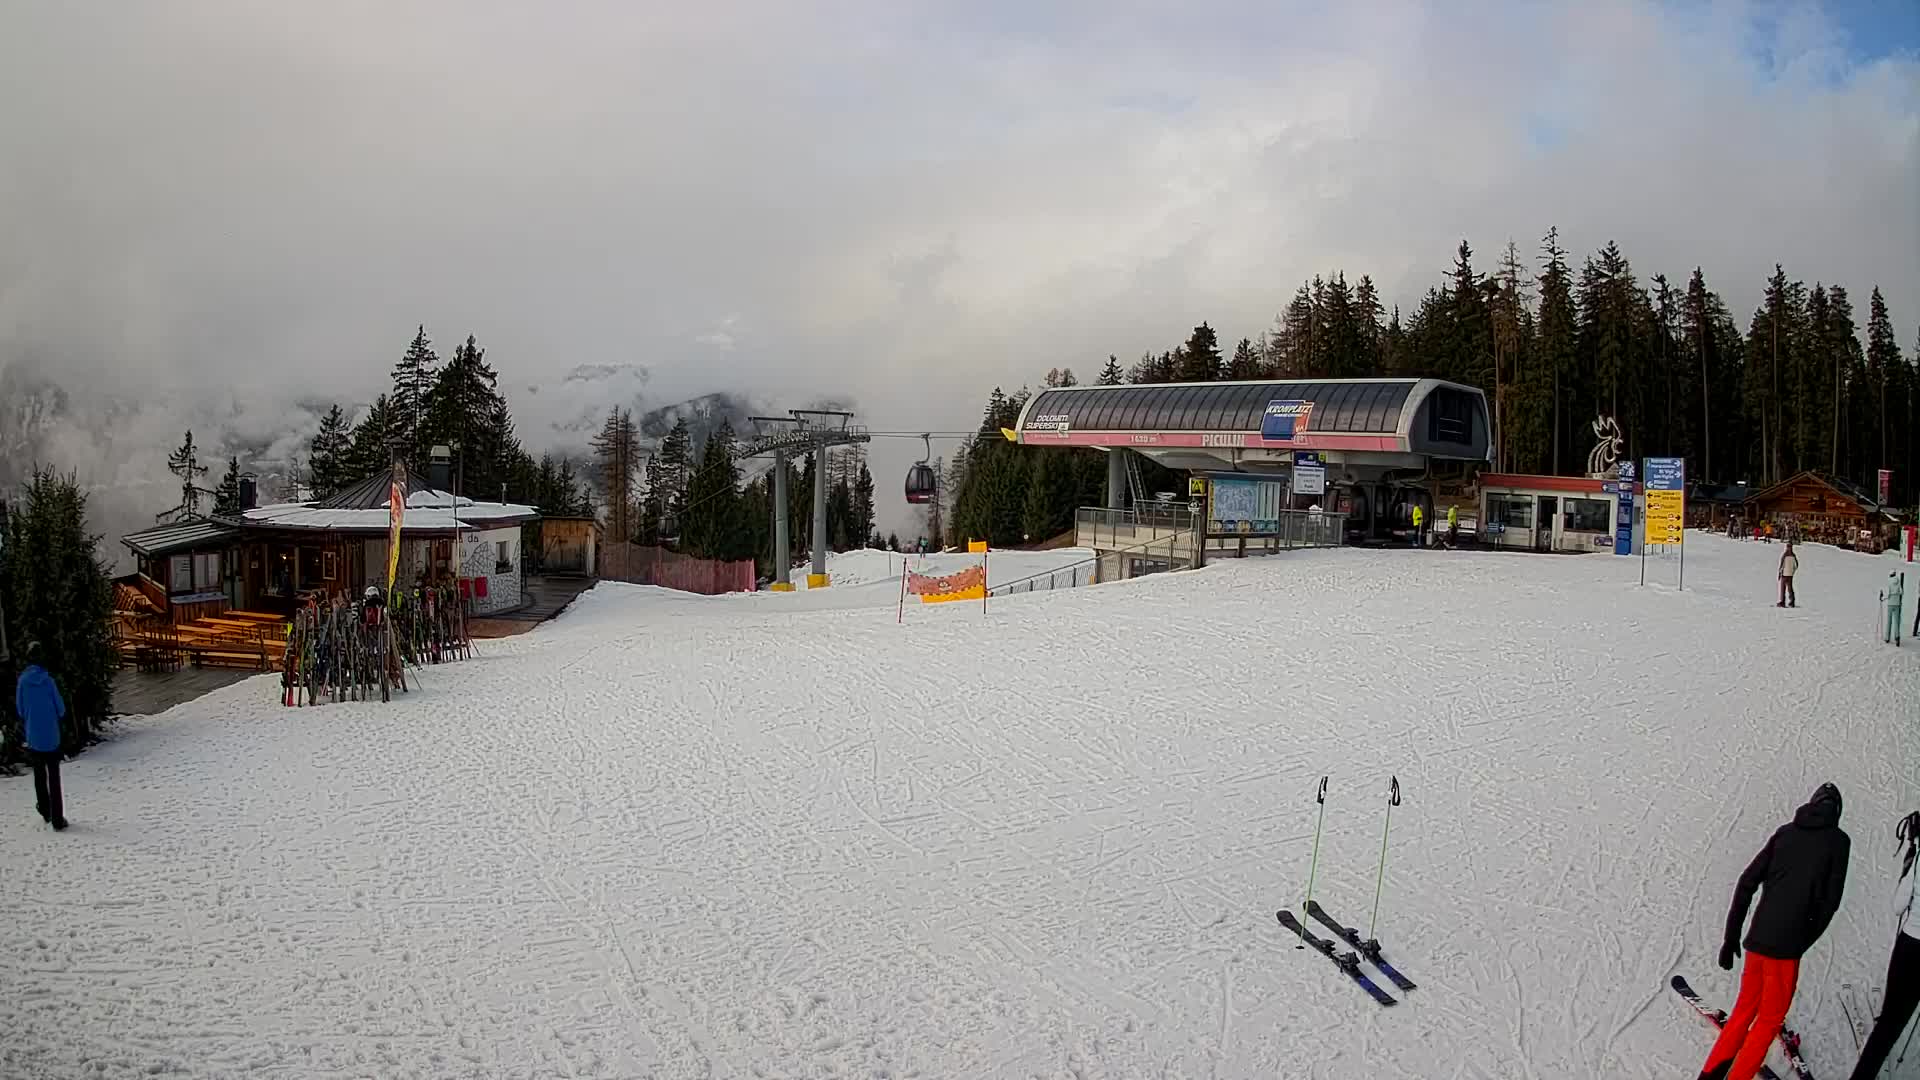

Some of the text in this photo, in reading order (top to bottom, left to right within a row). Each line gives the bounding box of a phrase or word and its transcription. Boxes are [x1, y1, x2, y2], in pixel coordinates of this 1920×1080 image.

[1266, 405, 1313, 414] KRONPLATZ
[1036, 414, 1069, 422] DOLOMITI
[1026, 422, 1059, 430] SUPERSKI
[1202, 434, 1245, 447] PICULIN
